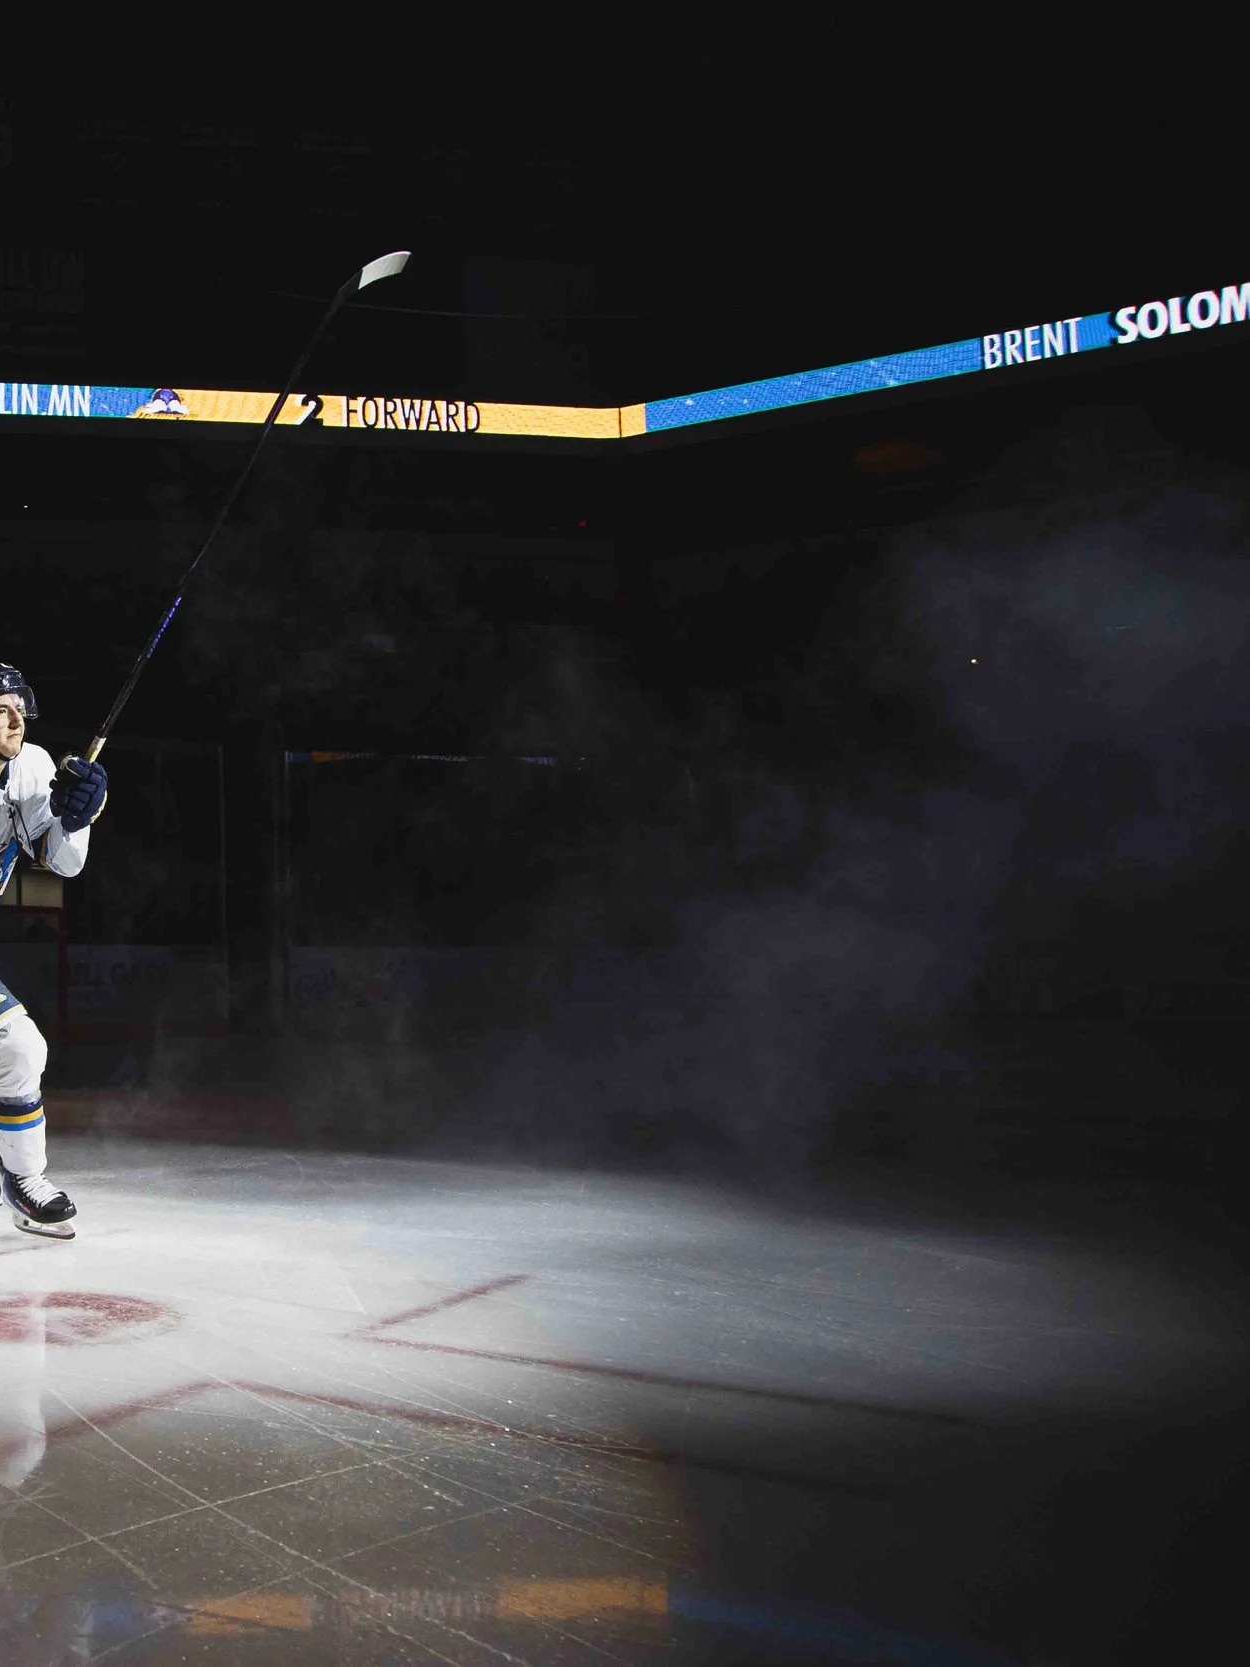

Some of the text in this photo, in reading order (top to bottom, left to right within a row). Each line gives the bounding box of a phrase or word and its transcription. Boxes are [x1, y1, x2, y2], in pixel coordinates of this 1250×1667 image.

[983, 282, 1250, 370] BRENT SOLOM
[299, 393, 481, 434] 2 FORWARD
